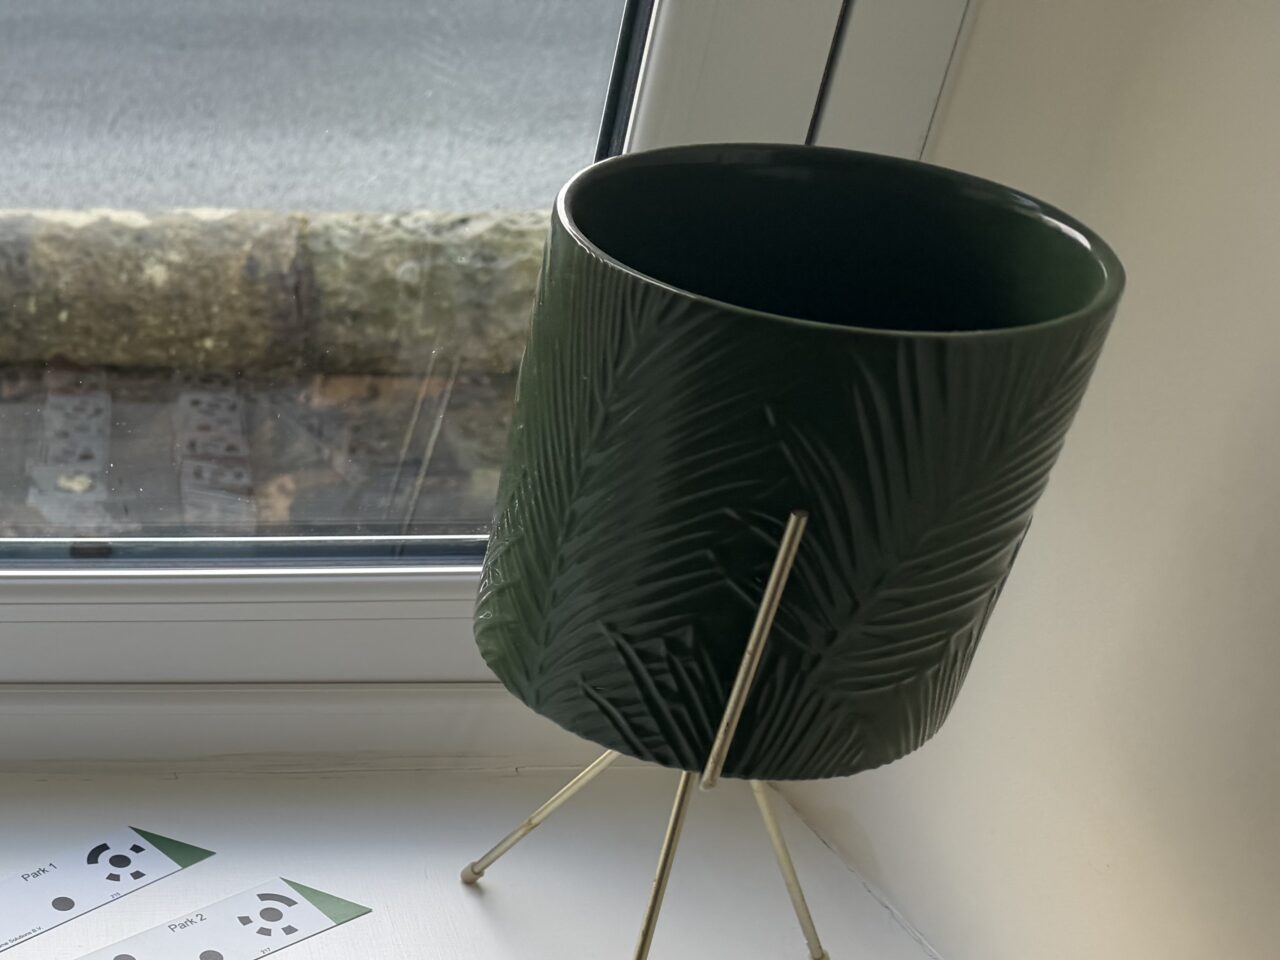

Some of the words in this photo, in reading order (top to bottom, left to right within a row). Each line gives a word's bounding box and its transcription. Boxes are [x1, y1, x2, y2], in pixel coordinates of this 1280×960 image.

[21, 866, 49, 882] Park
[48, 862, 57, 870] 1
[167, 919, 197, 933] Park
[198, 913, 208, 922] 2
[8, 931, 32, 944] Solutions
